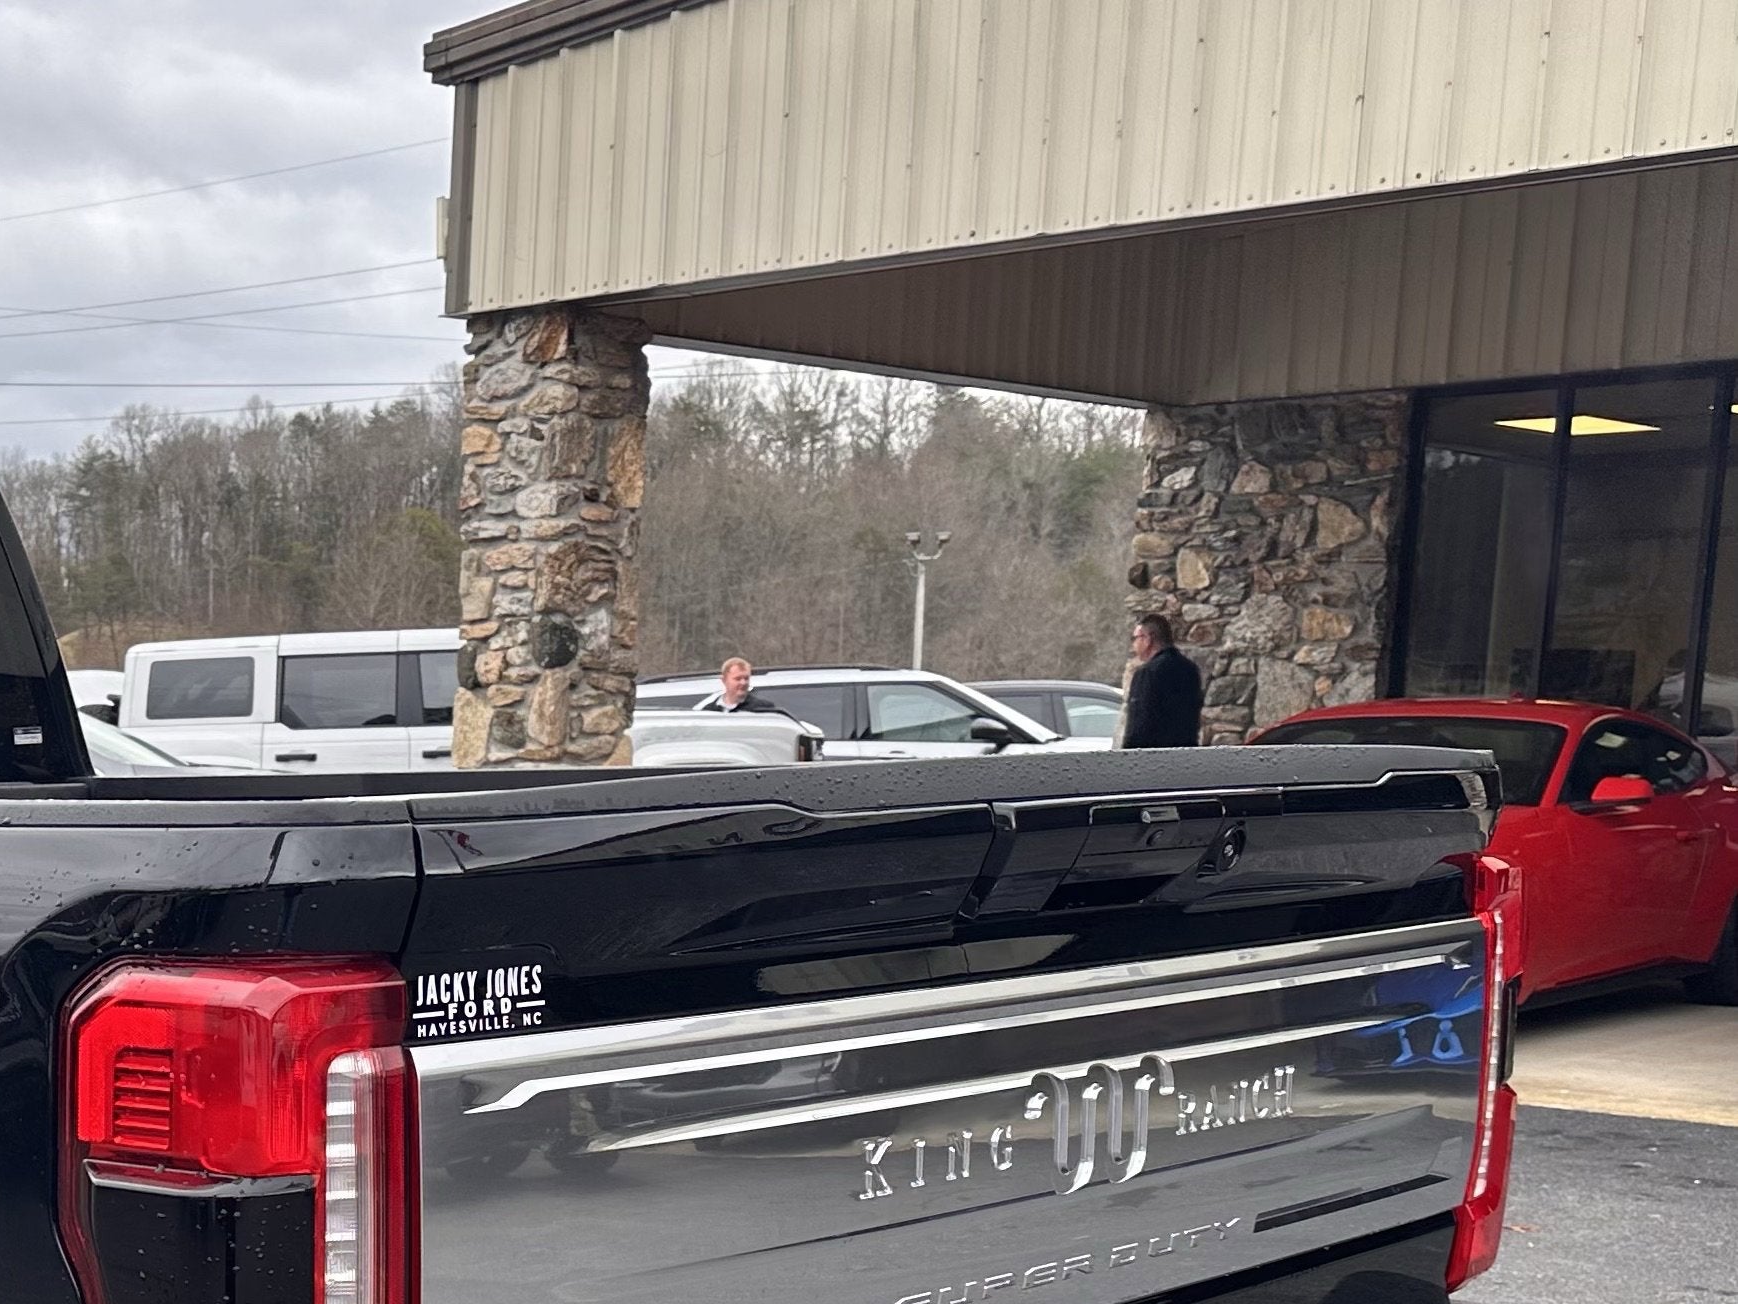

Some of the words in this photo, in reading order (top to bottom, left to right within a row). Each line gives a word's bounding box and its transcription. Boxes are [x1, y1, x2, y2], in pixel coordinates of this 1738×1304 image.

[416, 970, 478, 1007] JACKY
[485, 964, 543, 999] JONES
[417, 1017, 516, 1038] HAYESVILLE,
[522, 1011, 542, 1026] NC
[448, 997, 512, 1020] FORD
[858, 1122, 1014, 1201] KING
[1174, 1064, 1296, 1138] RANCH
[1109, 1216, 1241, 1270] DUTY
